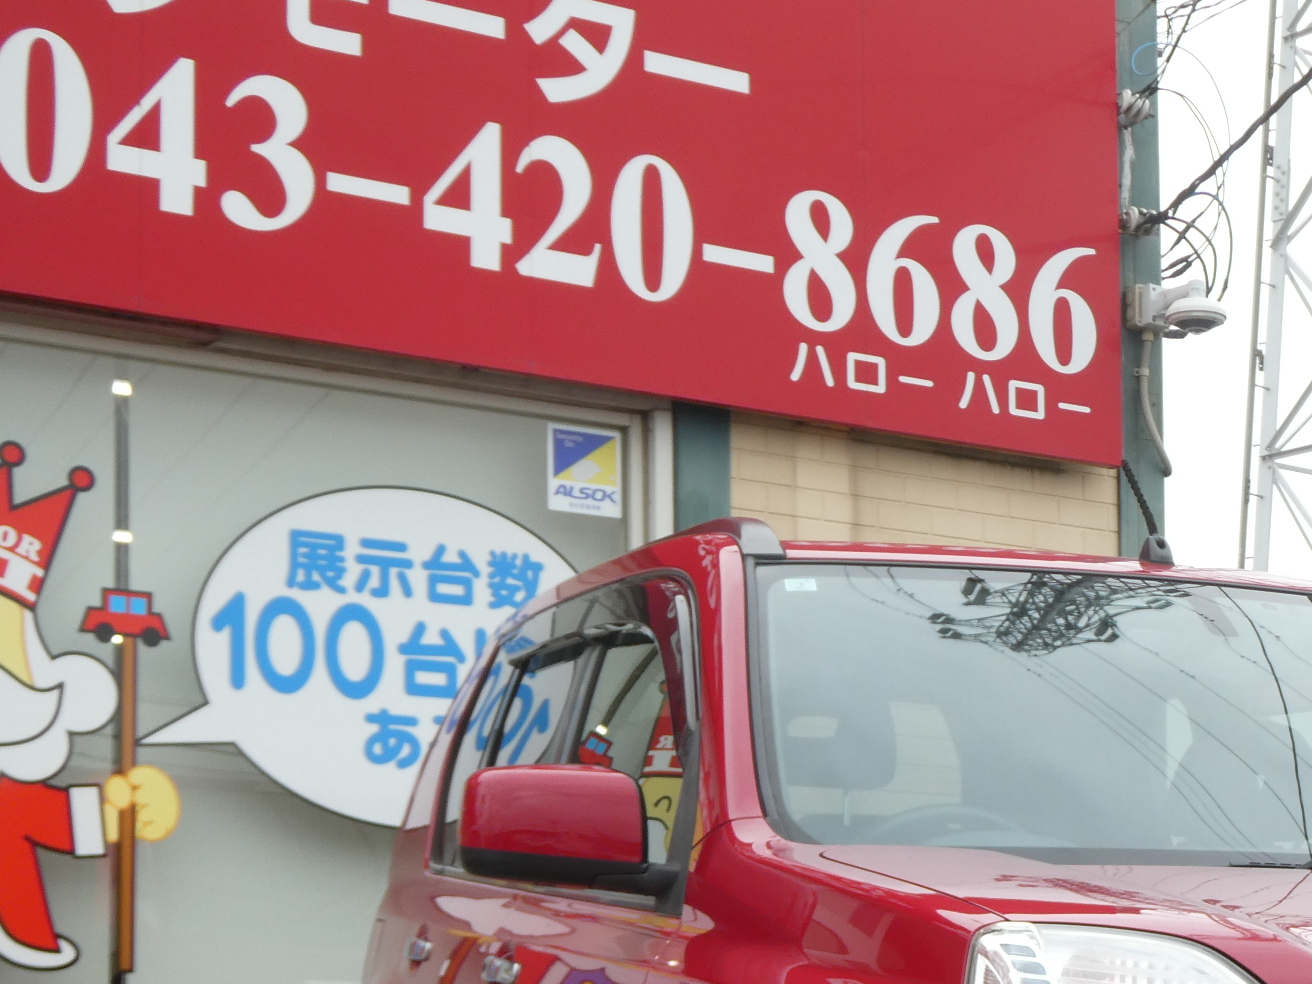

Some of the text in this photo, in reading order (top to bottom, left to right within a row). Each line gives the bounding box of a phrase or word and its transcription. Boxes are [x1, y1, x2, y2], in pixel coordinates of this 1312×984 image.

[789, 342, 1092, 420] ハロー ハロー
[553, 484, 617, 504] ALSOK
[286, 528, 544, 610] 展示台数
[210, 591, 487, 701] 100台
